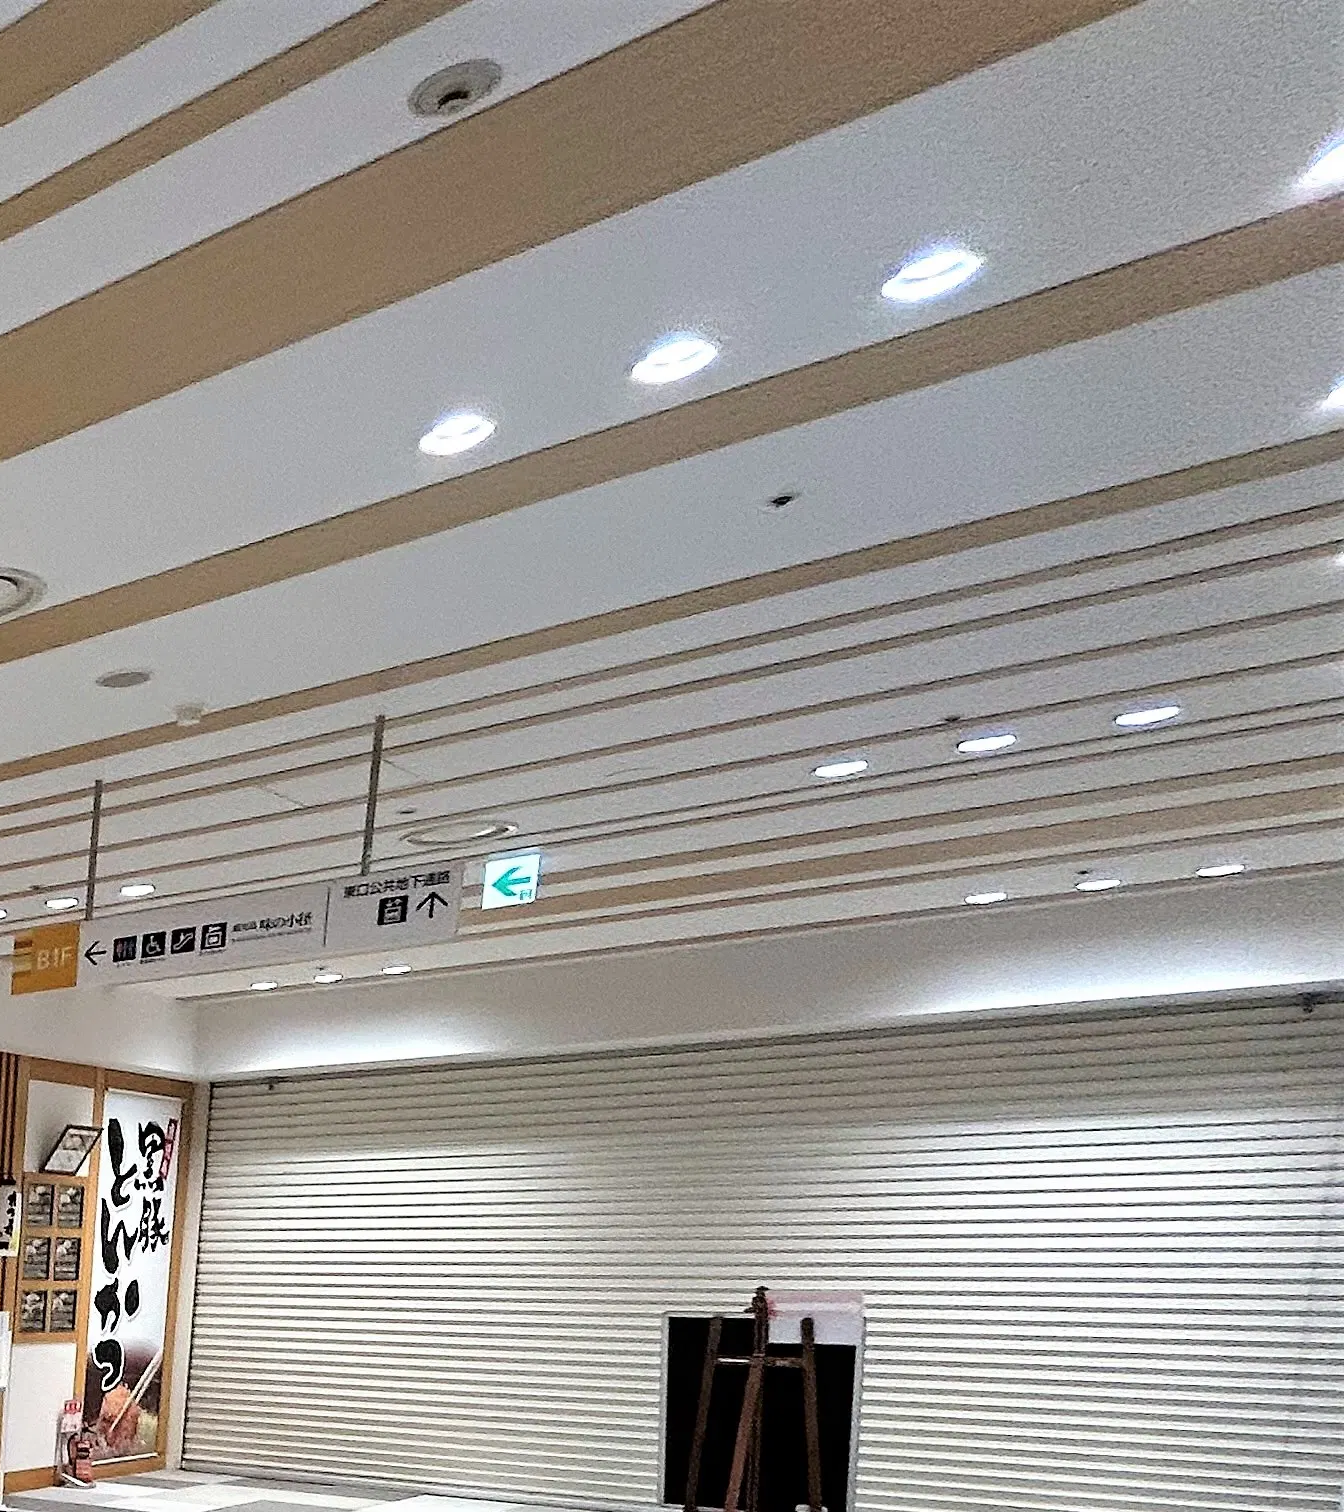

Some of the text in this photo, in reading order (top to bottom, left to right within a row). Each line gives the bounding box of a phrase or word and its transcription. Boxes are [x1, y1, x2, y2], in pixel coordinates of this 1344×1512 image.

[36, 946, 74, 971] B1F
[93, 1118, 140, 1388] とんかつ
[134, 1120, 170, 1253] 黒豚
